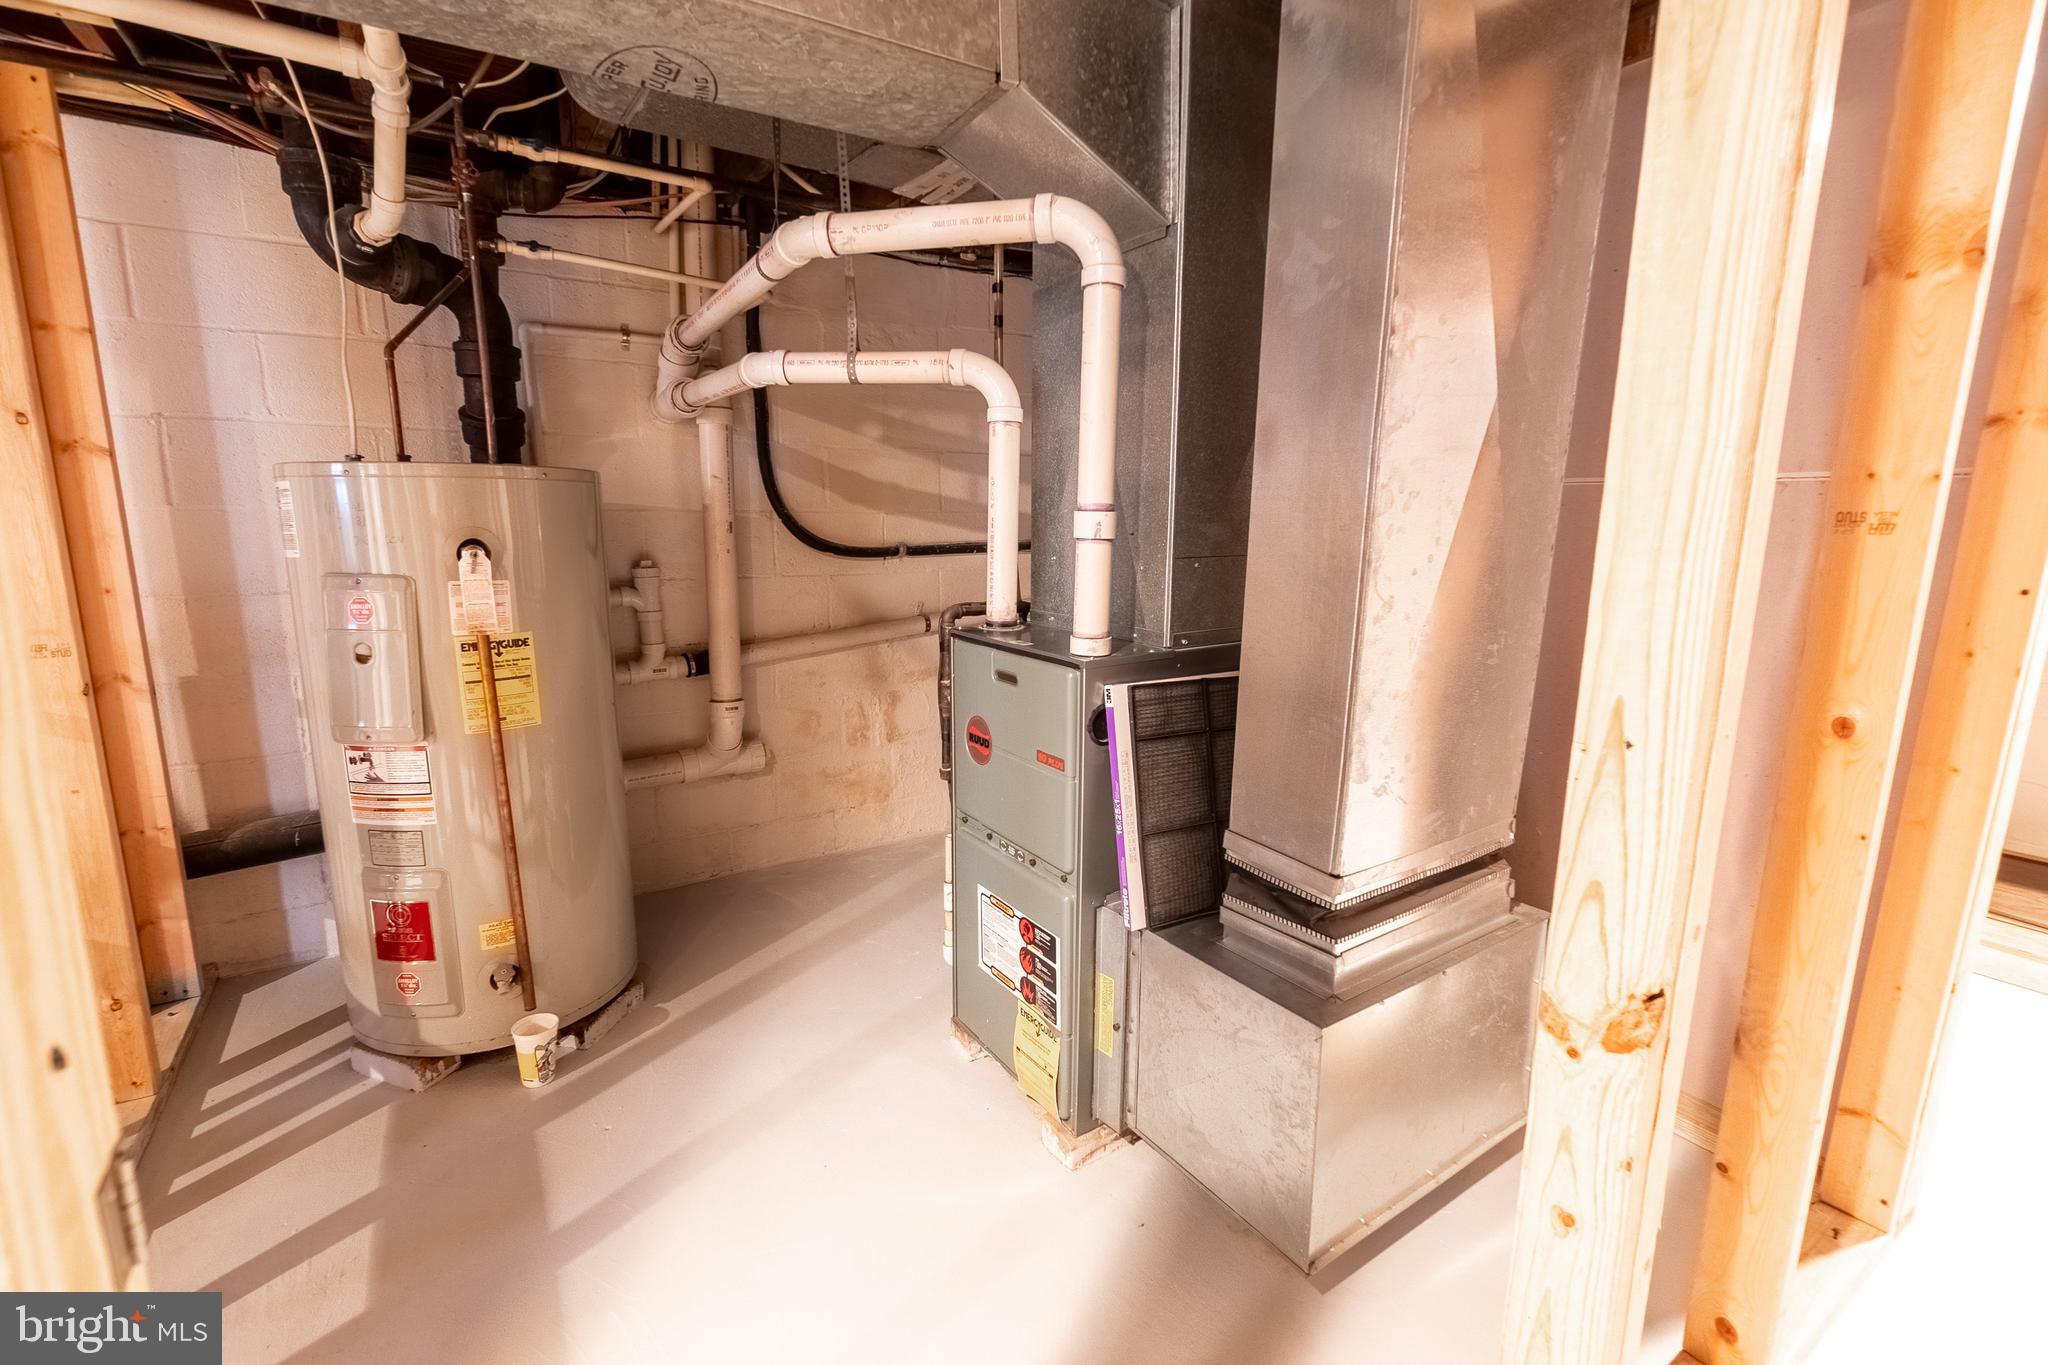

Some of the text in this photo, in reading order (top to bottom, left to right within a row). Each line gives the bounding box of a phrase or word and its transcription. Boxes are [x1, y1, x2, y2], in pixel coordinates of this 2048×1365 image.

[50, 647, 72, 658] STUD
[1105, 688, 1112, 704] 3M
[968, 732, 991, 749] RUUD
[380, 933, 425, 941] SELECT
